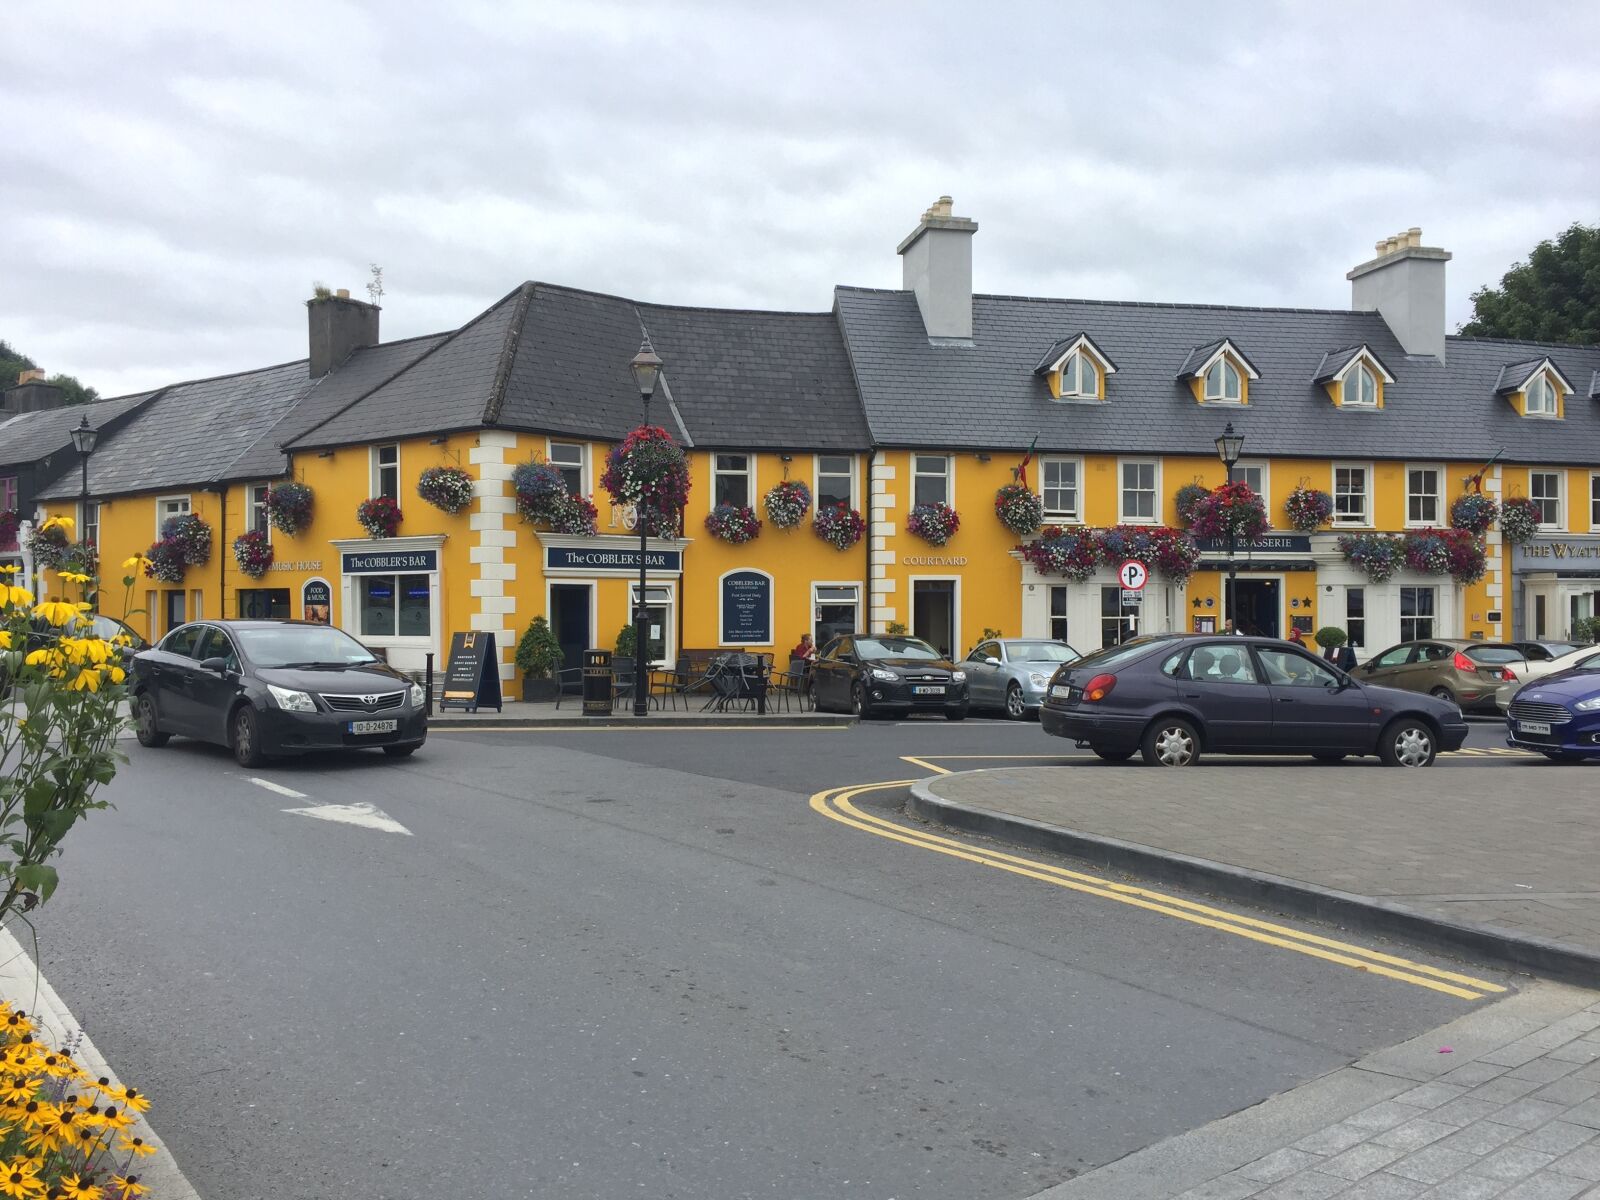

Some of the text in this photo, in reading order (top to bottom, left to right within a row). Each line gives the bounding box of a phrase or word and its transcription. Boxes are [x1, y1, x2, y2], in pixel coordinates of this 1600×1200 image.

[1522, 545, 1551, 558] THE
[271, 560, 323, 571] MUSIC HOUSE
[350, 555, 427, 568] The COBBLER'S BAR
[565, 552, 585, 563] The
[645, 554, 666, 566] BAR
[903, 556, 968, 566] COURTYARD
[1128, 566, 1138, 586] P
